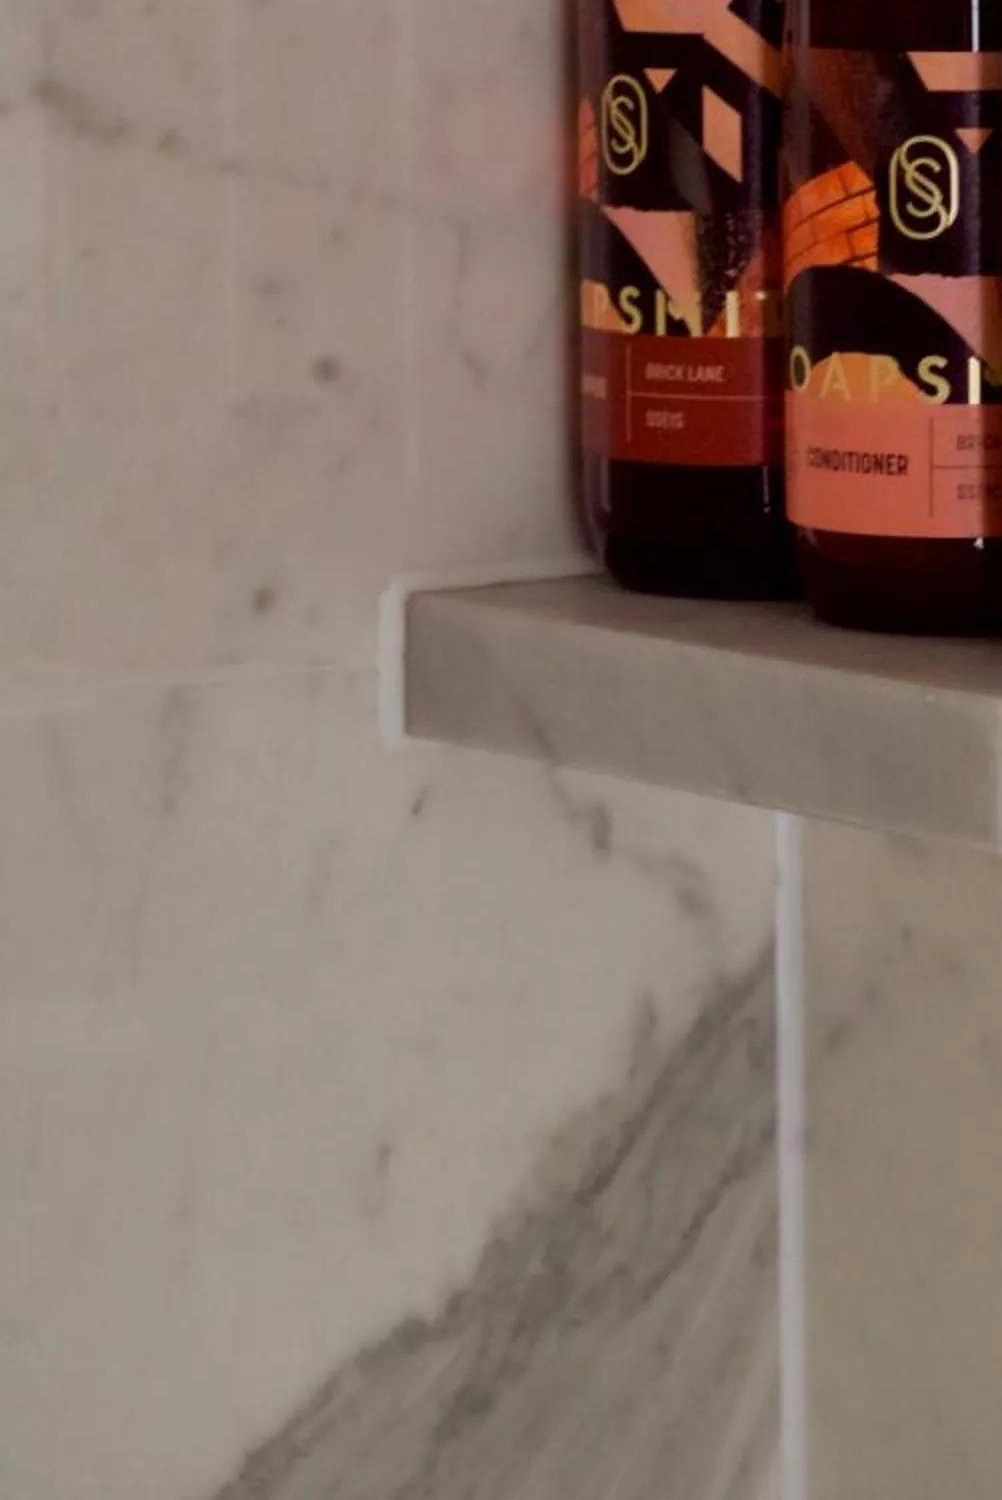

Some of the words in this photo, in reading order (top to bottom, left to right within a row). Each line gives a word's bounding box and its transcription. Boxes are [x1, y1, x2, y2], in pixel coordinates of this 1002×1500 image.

[645, 362, 685, 381] BRICK
[687, 365, 725, 383] LANE
[807, 445, 910, 477] CONDITIONER
